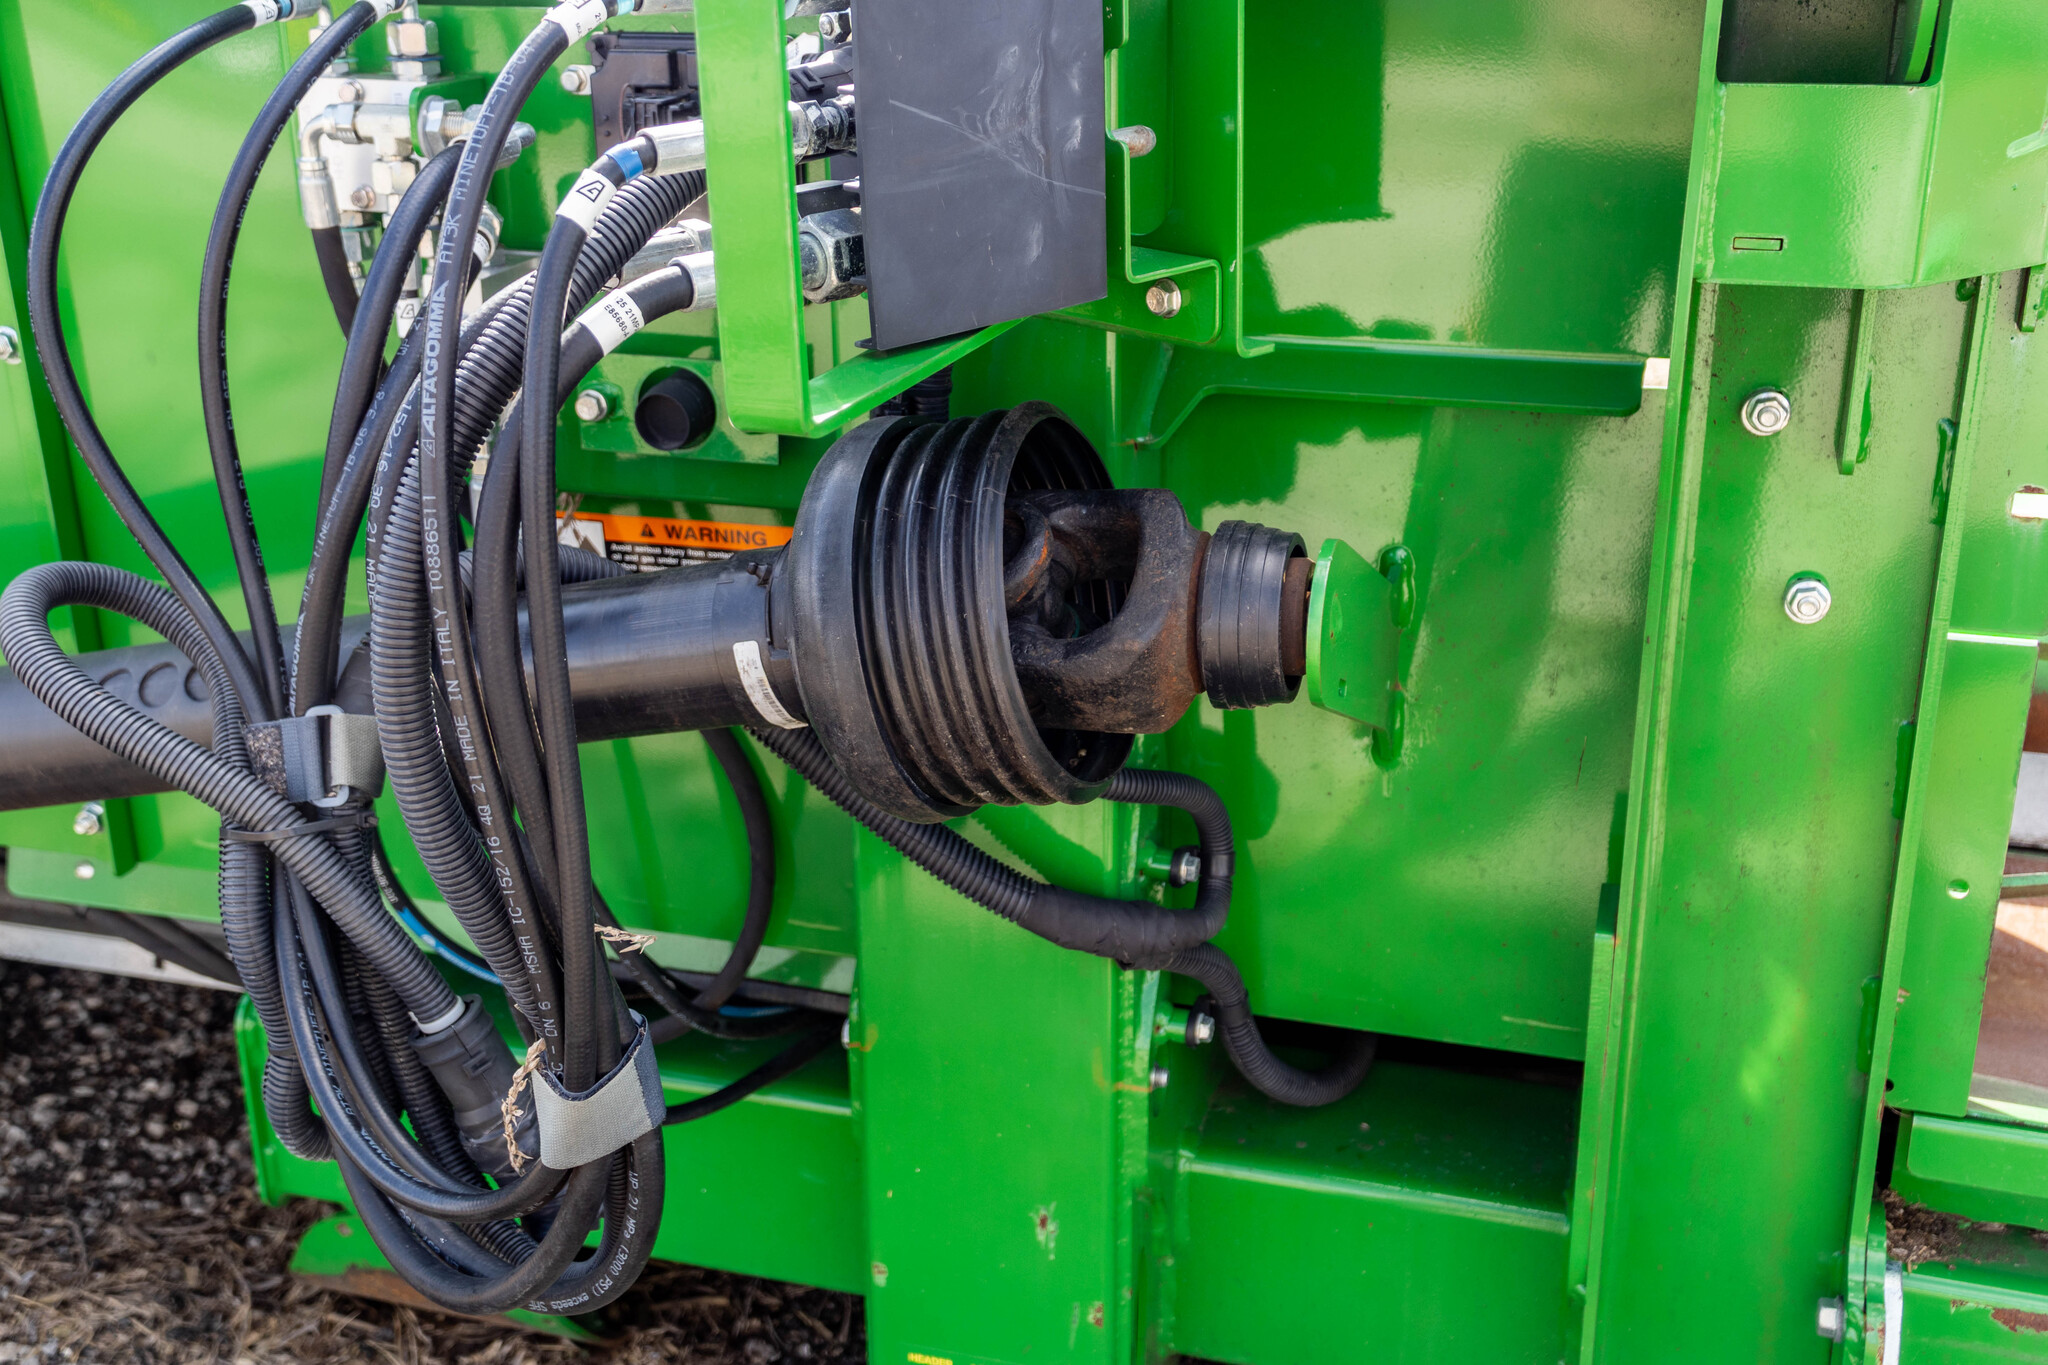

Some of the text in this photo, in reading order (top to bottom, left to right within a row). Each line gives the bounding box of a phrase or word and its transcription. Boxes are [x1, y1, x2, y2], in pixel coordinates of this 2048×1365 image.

[421, 279, 449, 437] ALFAGOMMA
[440, 213, 461, 263] AT3K
[289, 611, 306, 717] ALFAGOMMA
[397, 338, 410, 356] WP
[366, 522, 377, 543] 21
[665, 525, 767, 545] WARNING
[611, 542, 632, 553] Avoid
[687, 549, 706, 558] from
[624, 554, 639, 562] and
[657, 557, 679, 566] under
[434, 605, 456, 665] ITALY
[447, 680, 462, 702] IN
[456, 714, 477, 761] MADE
[471, 774, 485, 793] 21
[480, 804, 493, 825] 4Q
[489, 836, 525, 925] IC-152/16
[518, 935, 540, 975] MSHA
[538, 1001, 551, 1011] 6
[542, 1018, 558, 1037] DN
[628, 1193, 638, 1209] 21
[624, 1216, 636, 1239] MPa
[610, 1245, 629, 1276] (3000
[592, 1275, 614, 1297] PSI)
[551, 1292, 589, 1310] exceeds
